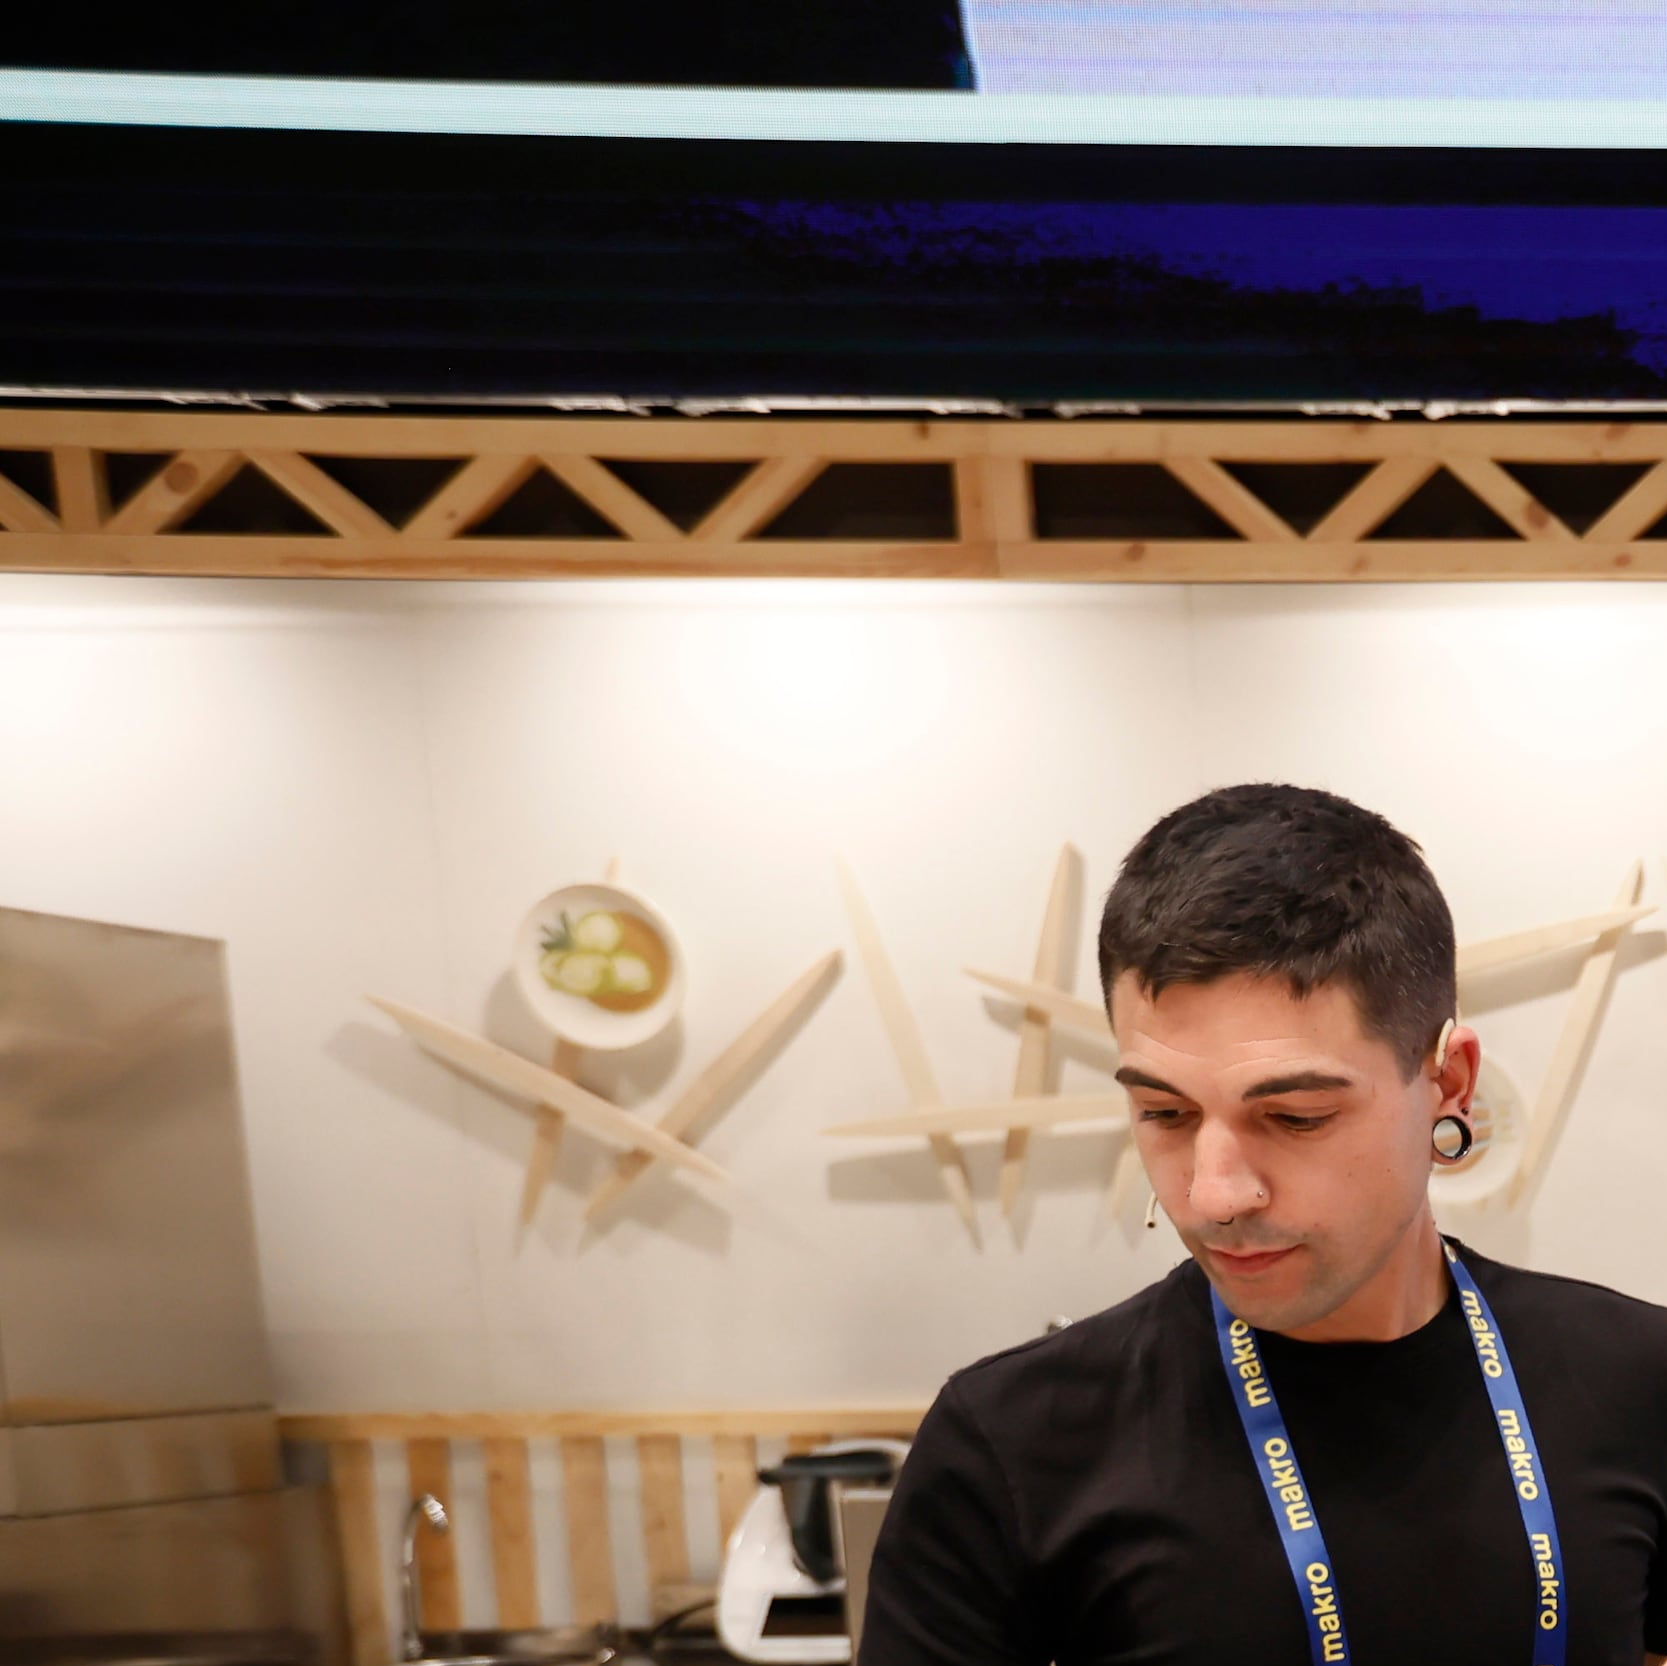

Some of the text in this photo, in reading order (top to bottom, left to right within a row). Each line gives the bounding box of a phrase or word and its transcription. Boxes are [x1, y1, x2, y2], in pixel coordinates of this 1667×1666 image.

[1229, 1318, 1272, 1408] makro
[1461, 1288, 1502, 1379] makro
[1264, 1437, 1313, 1531] makro
[1498, 1408, 1538, 1501] makro
[1305, 1562, 1345, 1662] makro
[1531, 1532, 1558, 1630] makro
